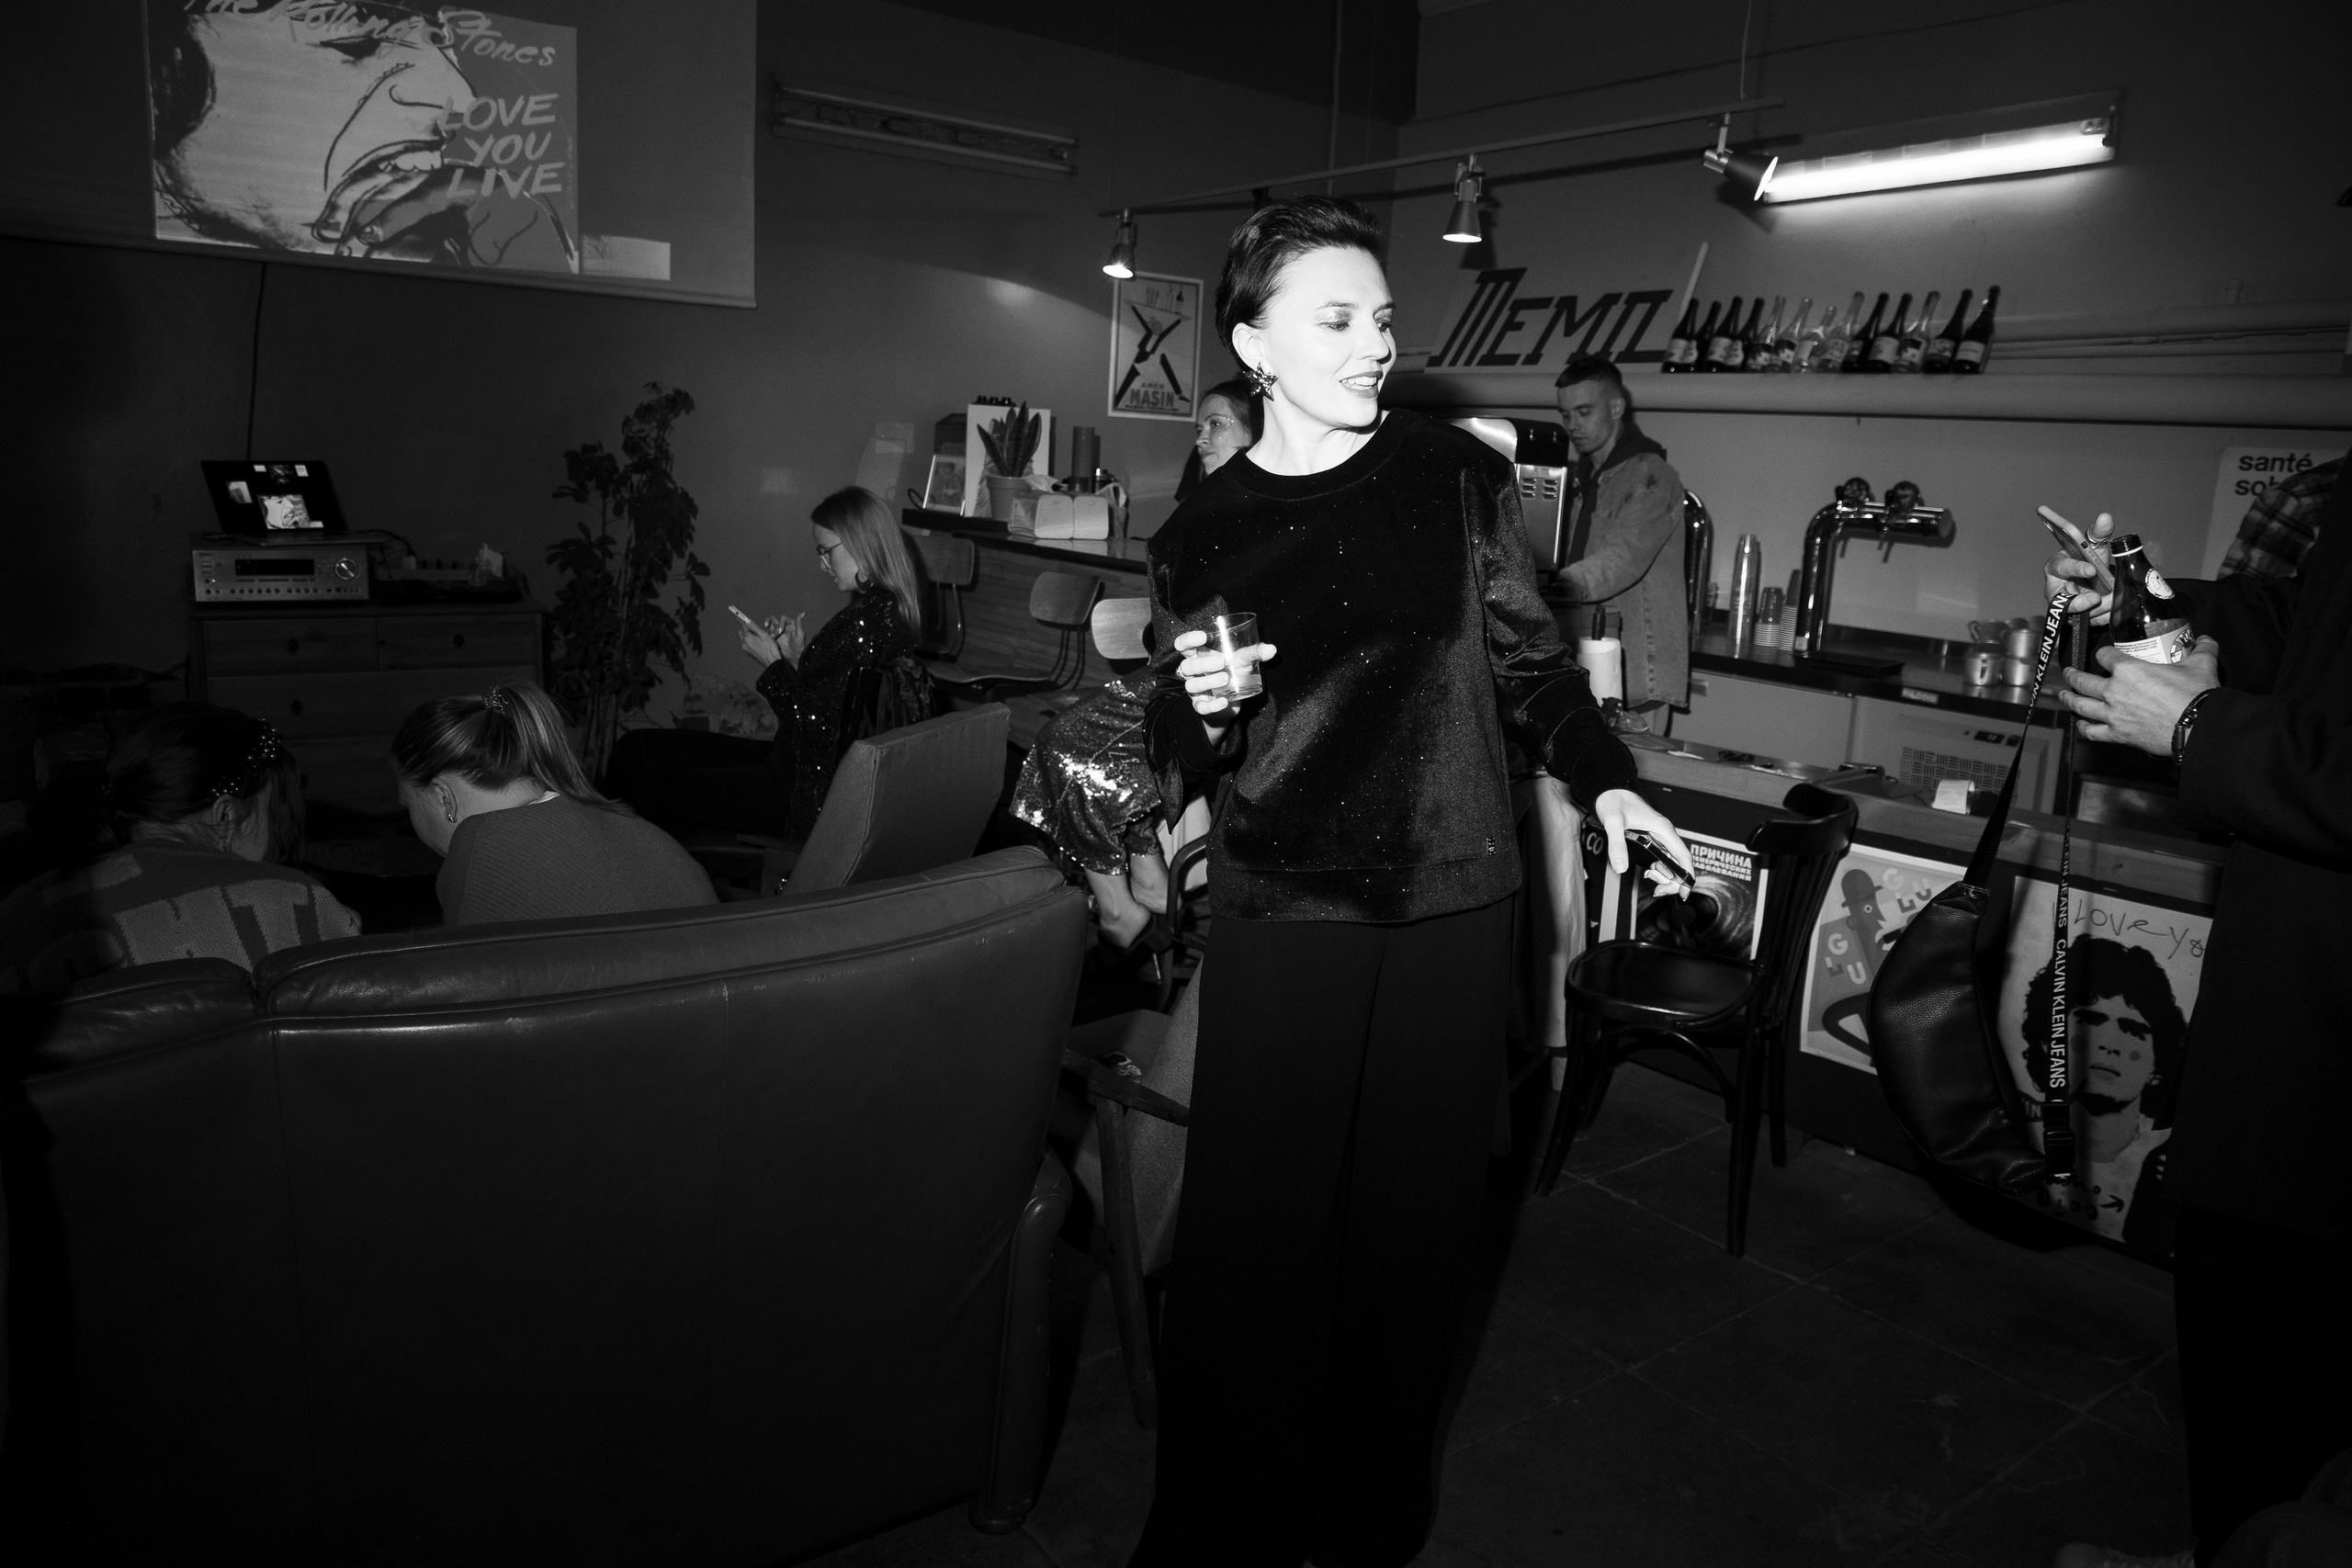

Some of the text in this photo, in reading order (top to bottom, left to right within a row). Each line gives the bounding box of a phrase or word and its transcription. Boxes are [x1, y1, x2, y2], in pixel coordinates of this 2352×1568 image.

[437, 94, 559, 131] LOVE
[466, 132, 551, 167] YOU
[447, 162, 565, 199] LIVE
[1130, 389, 1174, 408] MASIN
[2239, 453, 2312, 473] santé
[2035, 636, 2054, 682] KLEIN
[1690, 843, 1752, 868] ПРИЧИНА
[2058, 879, 2069, 929] JEANS
[2050, 939, 2066, 1089] CALVIN KLEIN JEANS
